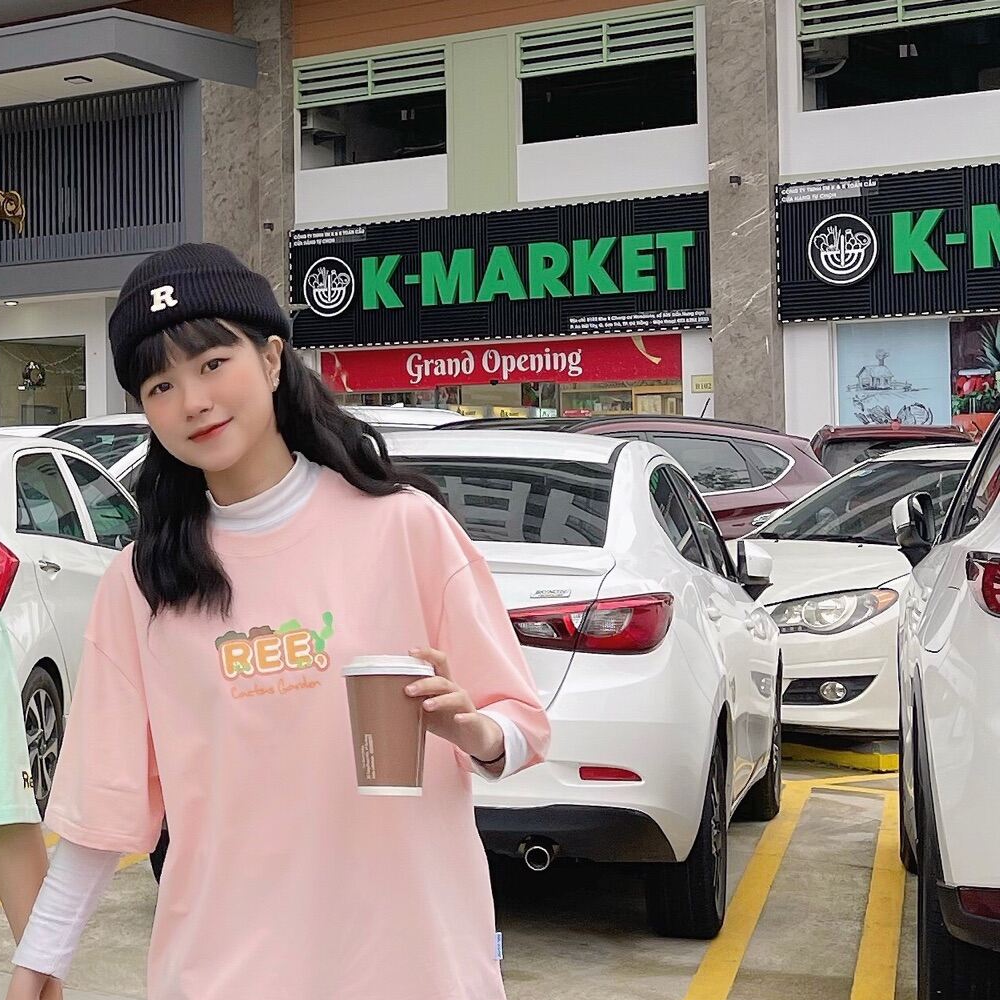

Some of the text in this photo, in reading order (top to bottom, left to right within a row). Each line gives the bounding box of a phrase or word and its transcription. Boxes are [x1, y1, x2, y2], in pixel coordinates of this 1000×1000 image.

[361, 230, 697, 311] K-MARKET
[150, 285, 178, 312] R
[406, 348, 583, 384] Grand Opening
